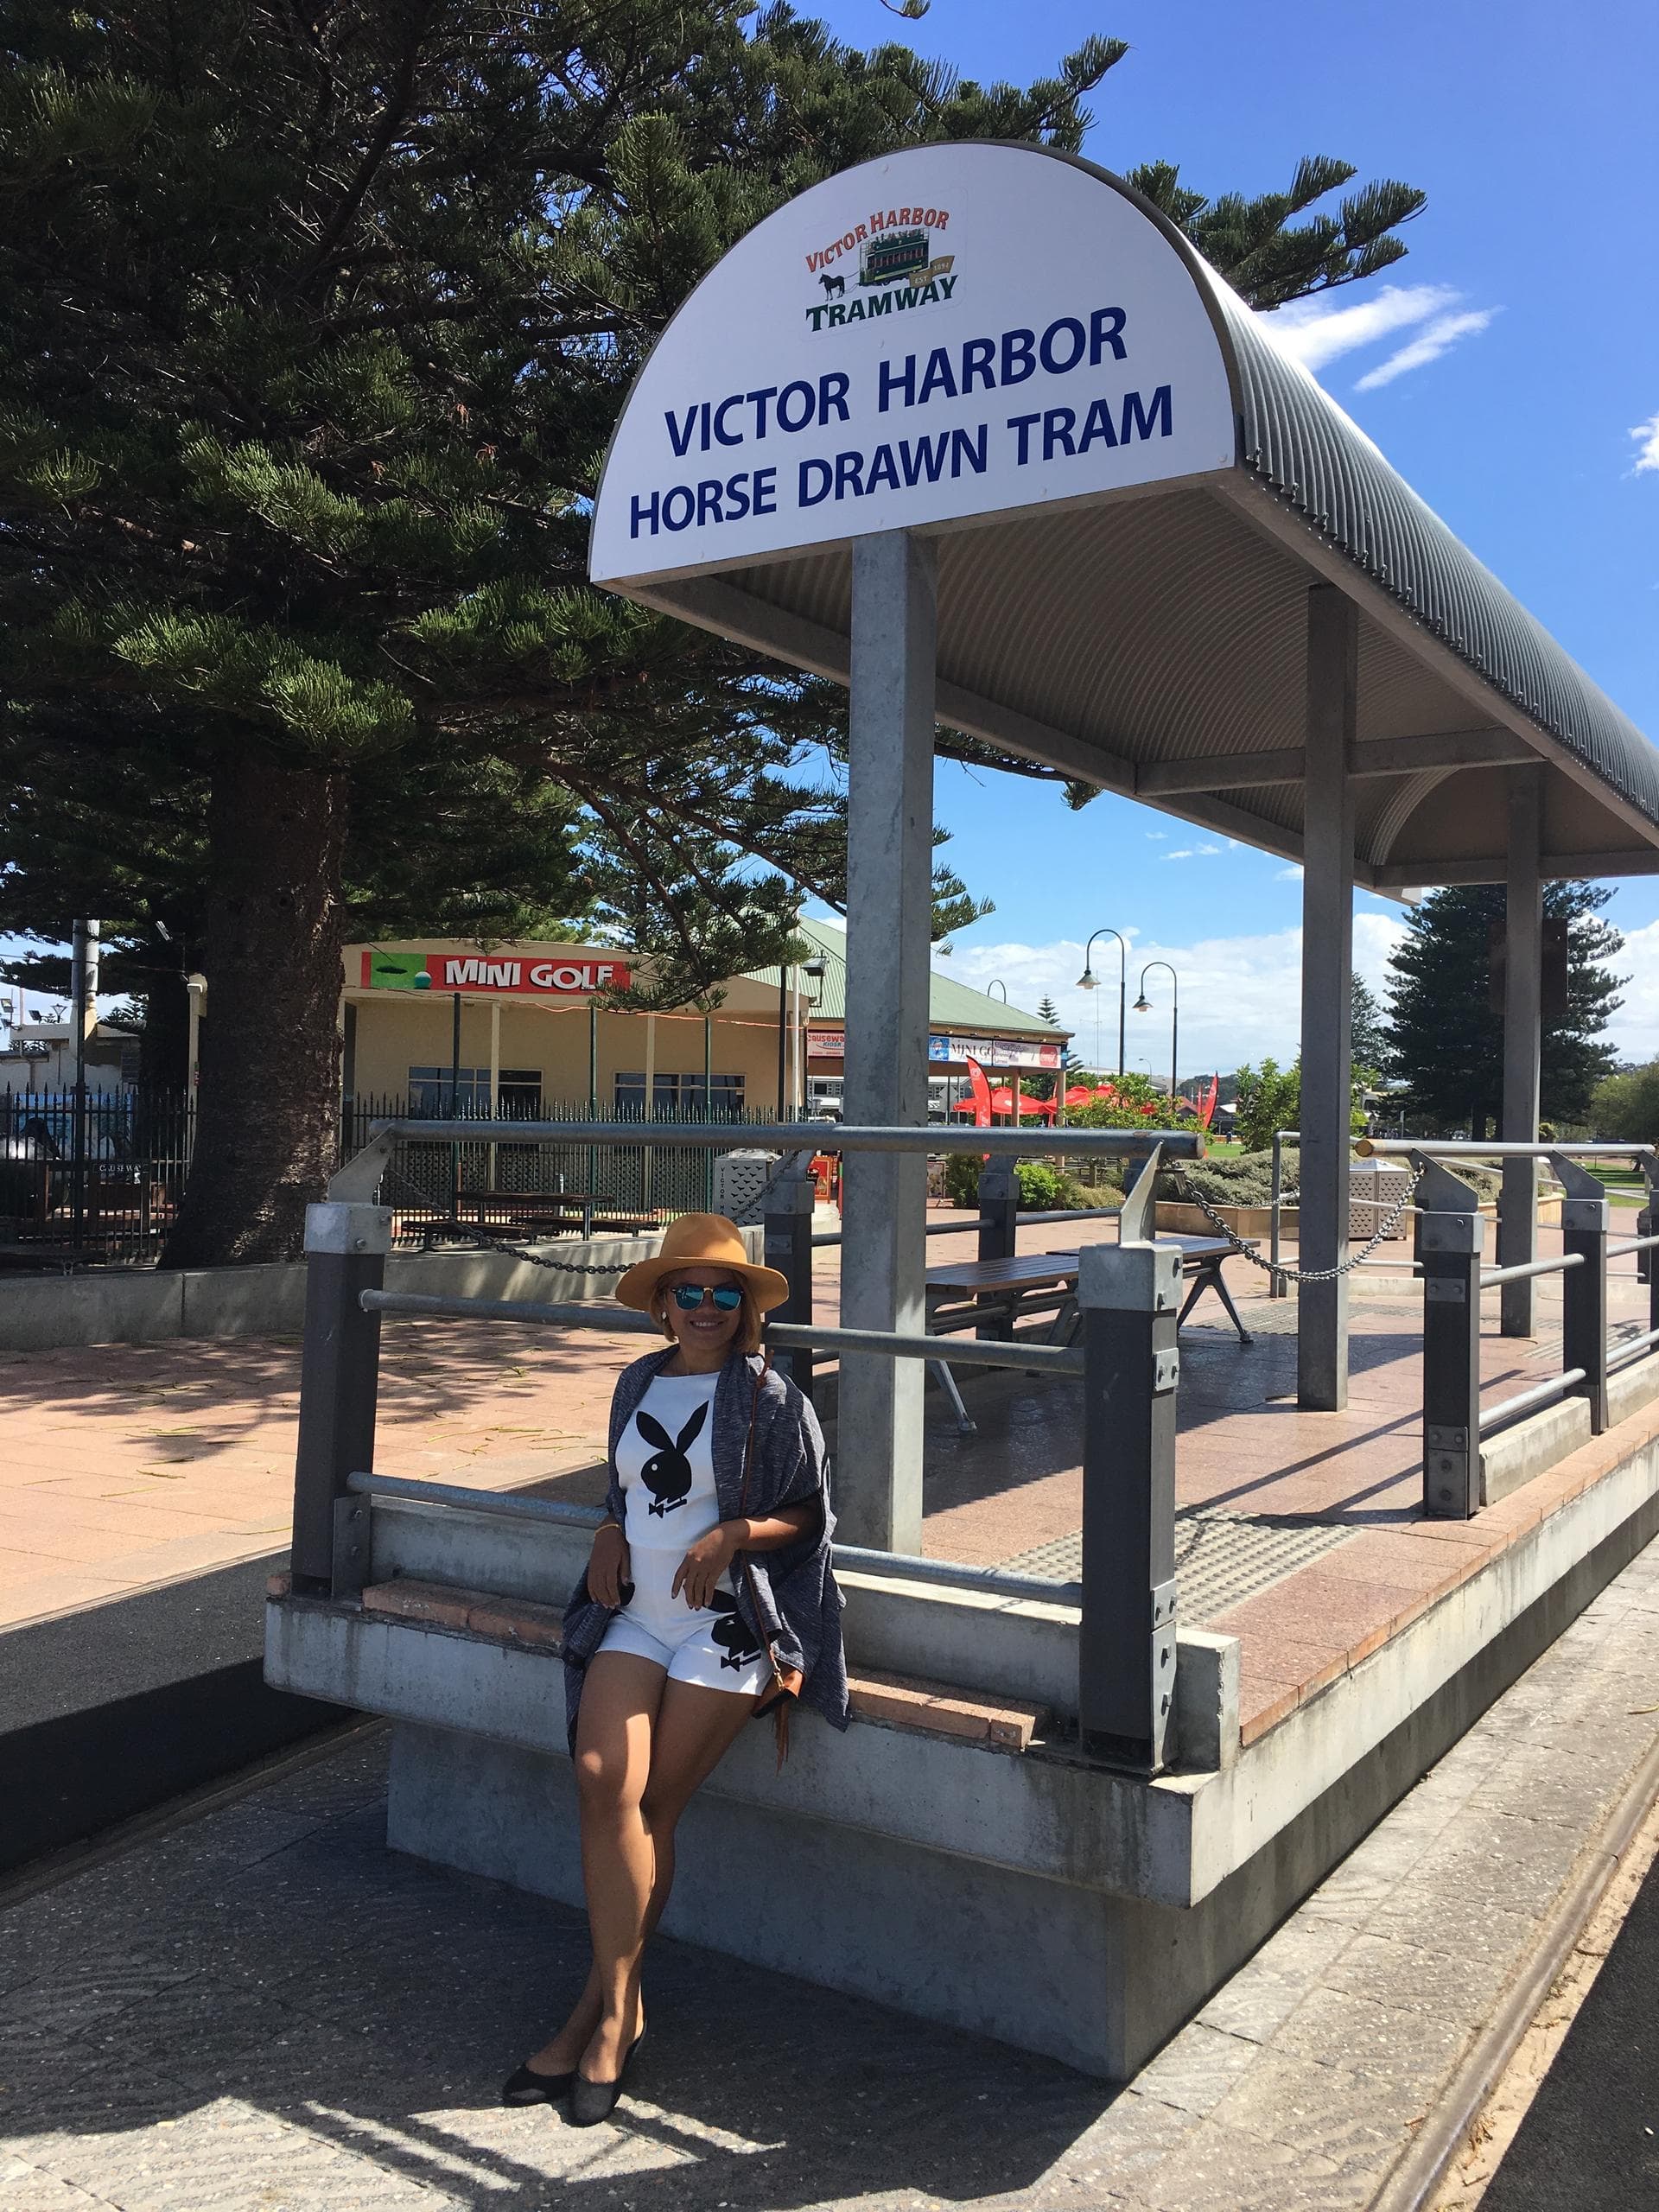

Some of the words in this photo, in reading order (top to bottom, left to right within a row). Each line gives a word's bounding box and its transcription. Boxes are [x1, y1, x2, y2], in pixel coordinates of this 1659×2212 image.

[805, 224, 868, 273] VICTOR
[869, 207, 950, 235] HARBOR
[805, 274, 959, 333] TRAMWAY
[664, 372, 850, 457] VICTOR
[878, 306, 1128, 413] HARBOR
[629, 467, 778, 539] HORSE
[798, 423, 988, 508] DRAWN
[1007, 385, 1173, 467] TRAM
[446, 959, 521, 987] MINI
[530, 964, 613, 991] GOLF
[951, 1043, 976, 1055] MINI
